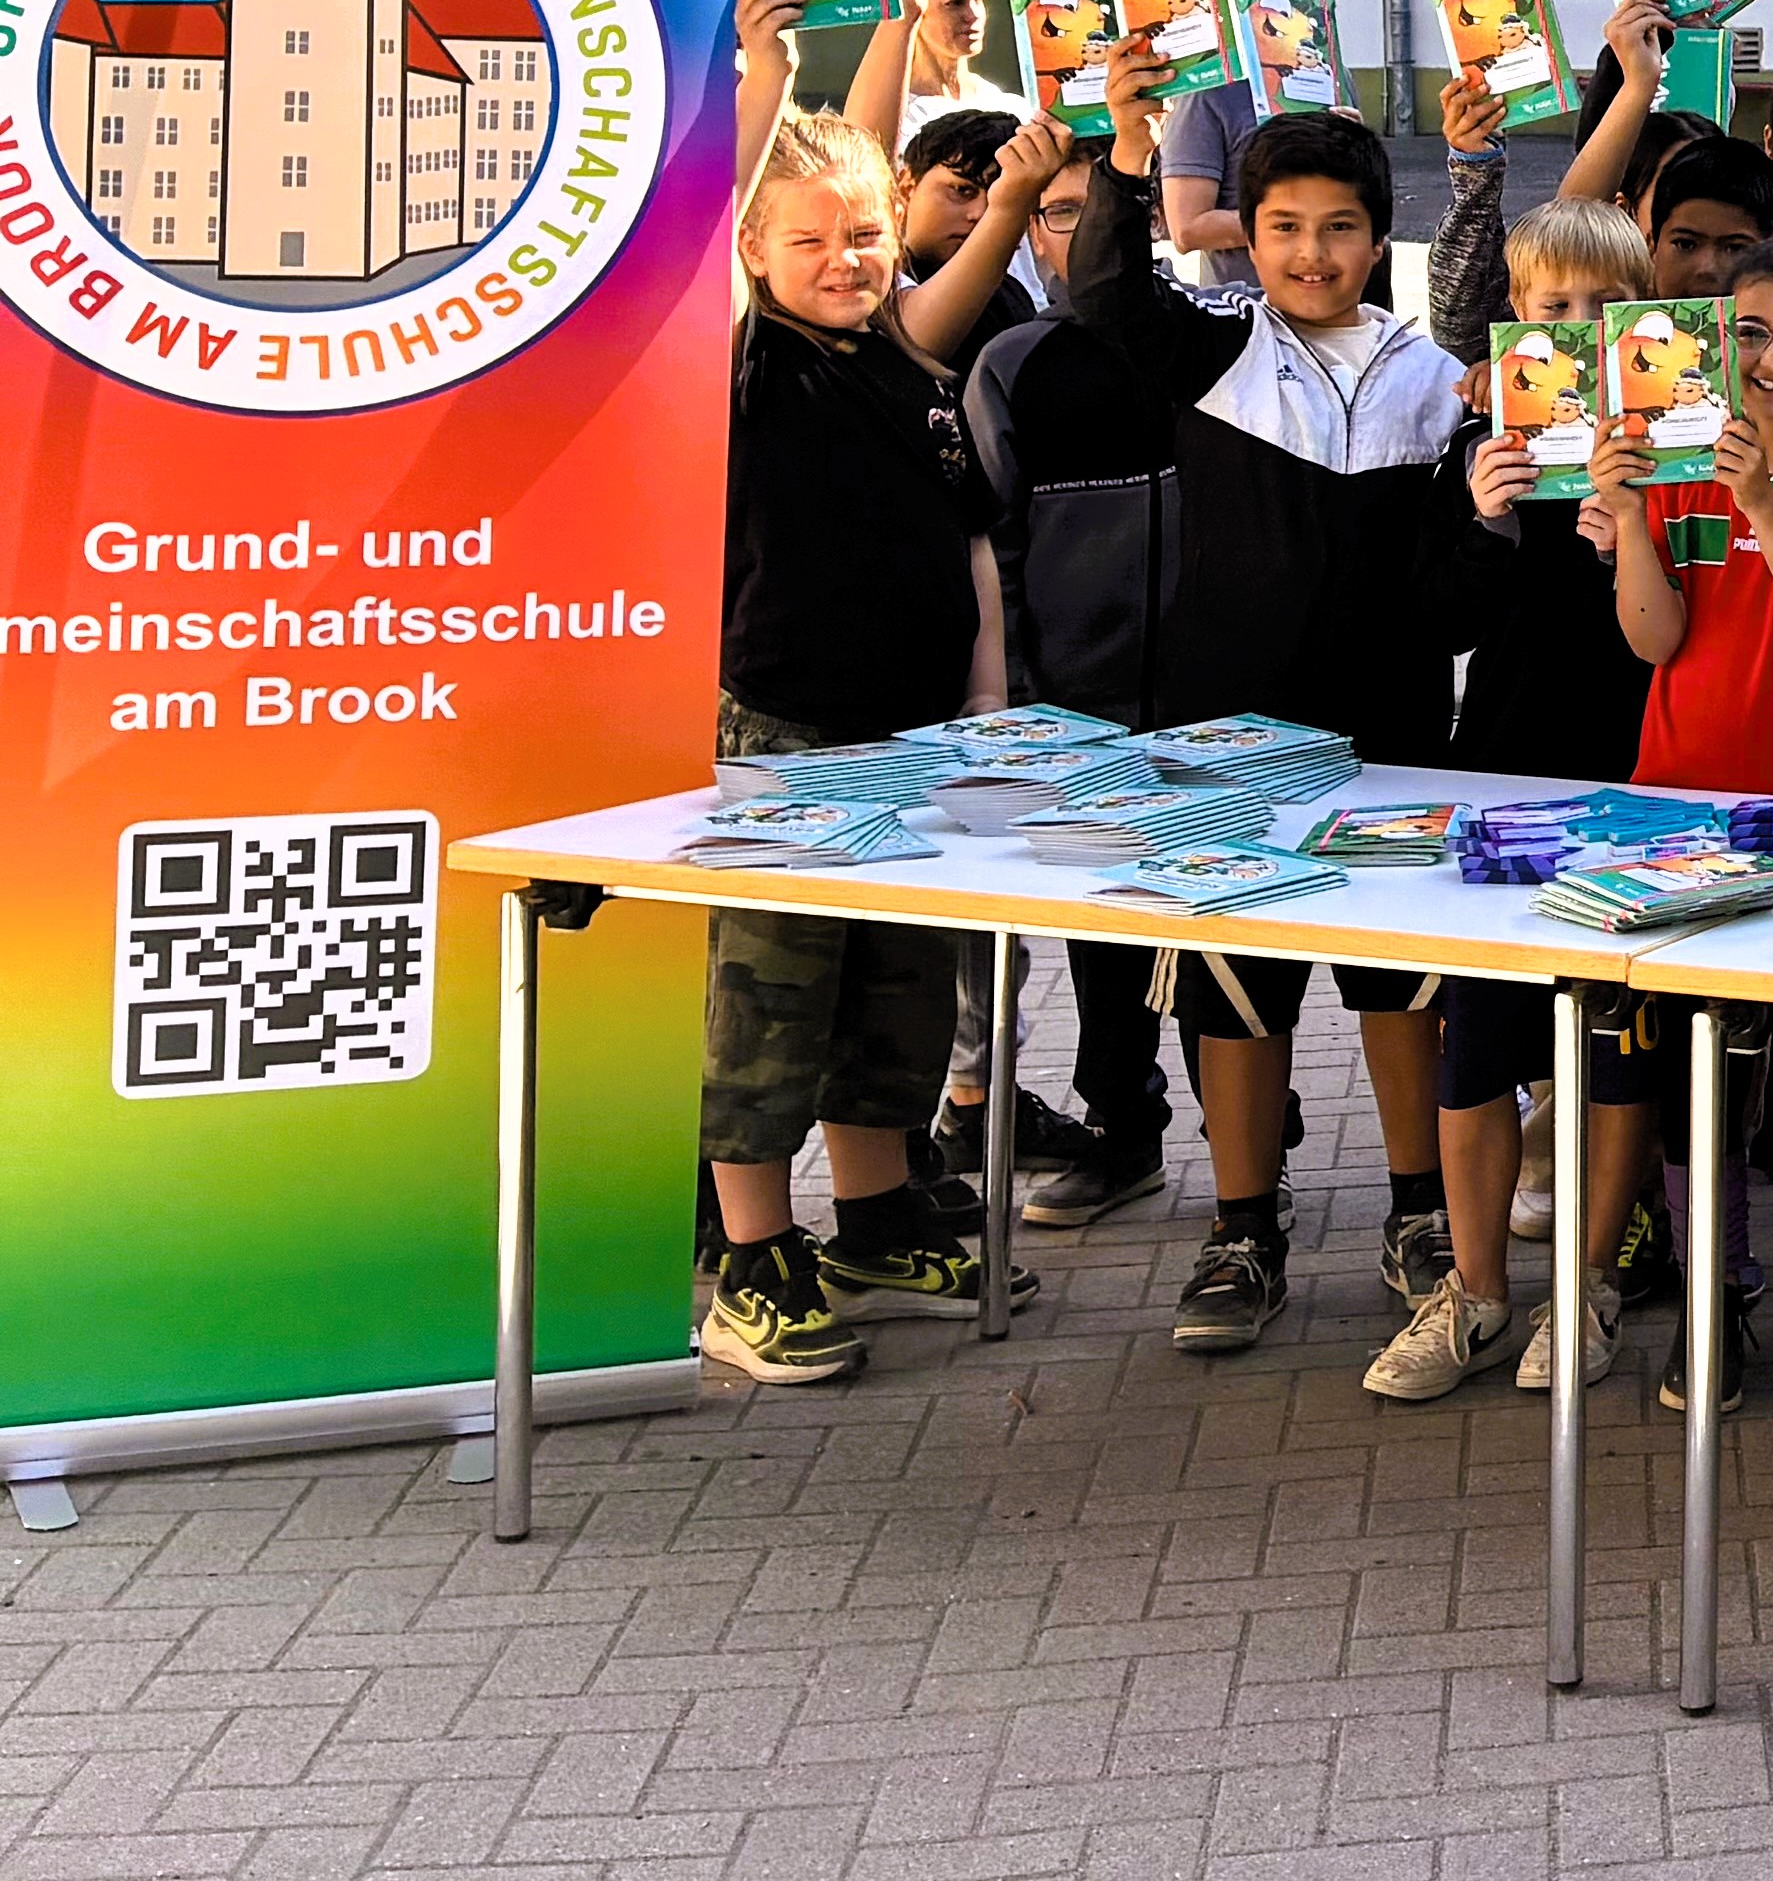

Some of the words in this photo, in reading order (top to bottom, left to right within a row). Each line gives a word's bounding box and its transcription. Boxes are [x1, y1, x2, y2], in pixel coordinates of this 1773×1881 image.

[125, 301, 238, 371] AM
[82, 521, 339, 574] Grund-
[362, 517, 494, 568] und
[110, 689, 217, 732] am
[246, 672, 460, 726] Brook
